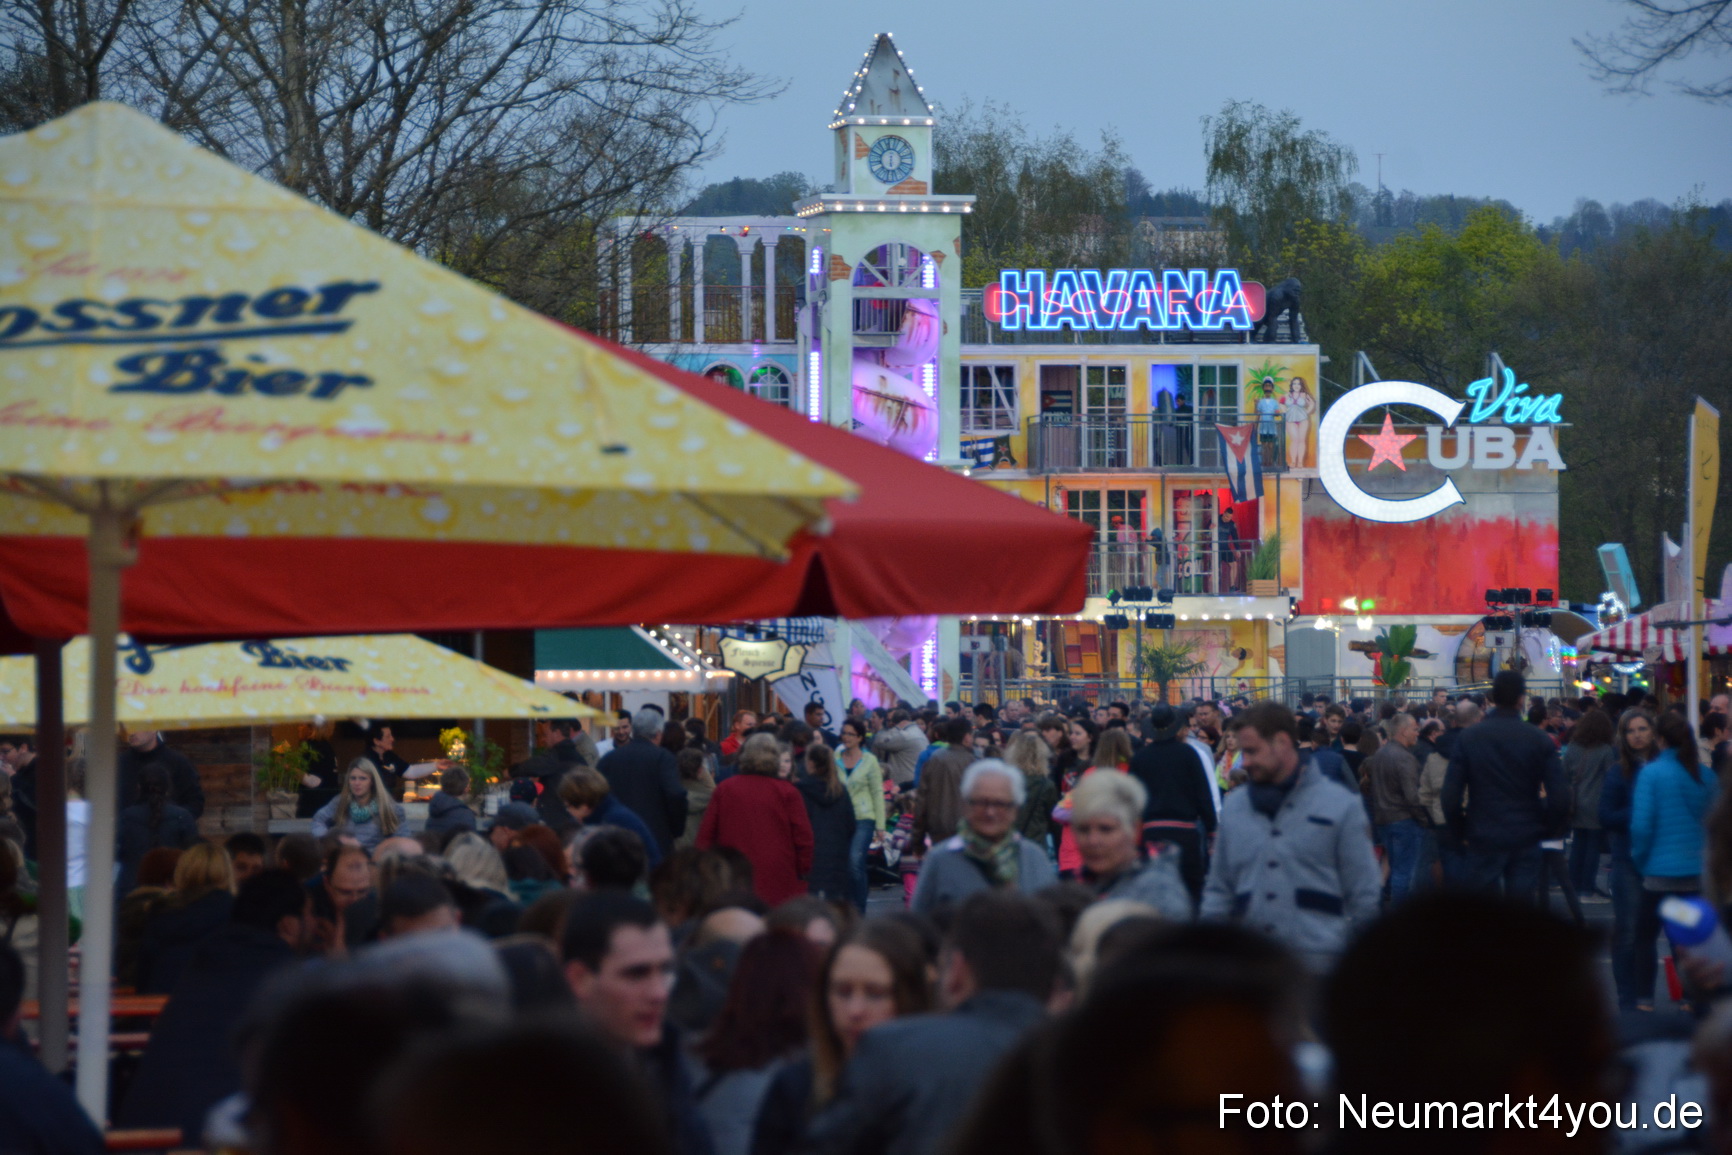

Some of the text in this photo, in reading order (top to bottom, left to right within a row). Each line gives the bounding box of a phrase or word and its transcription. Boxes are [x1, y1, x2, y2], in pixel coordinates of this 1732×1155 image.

[993, 289, 1255, 316] DISCOTECA
[1001, 270, 1253, 329] HAVANA
[107, 347, 375, 399] Bier
[1466, 367, 1563, 424] Viva
[1319, 380, 1567, 523] CUBA
[241, 638, 353, 672] Bier
